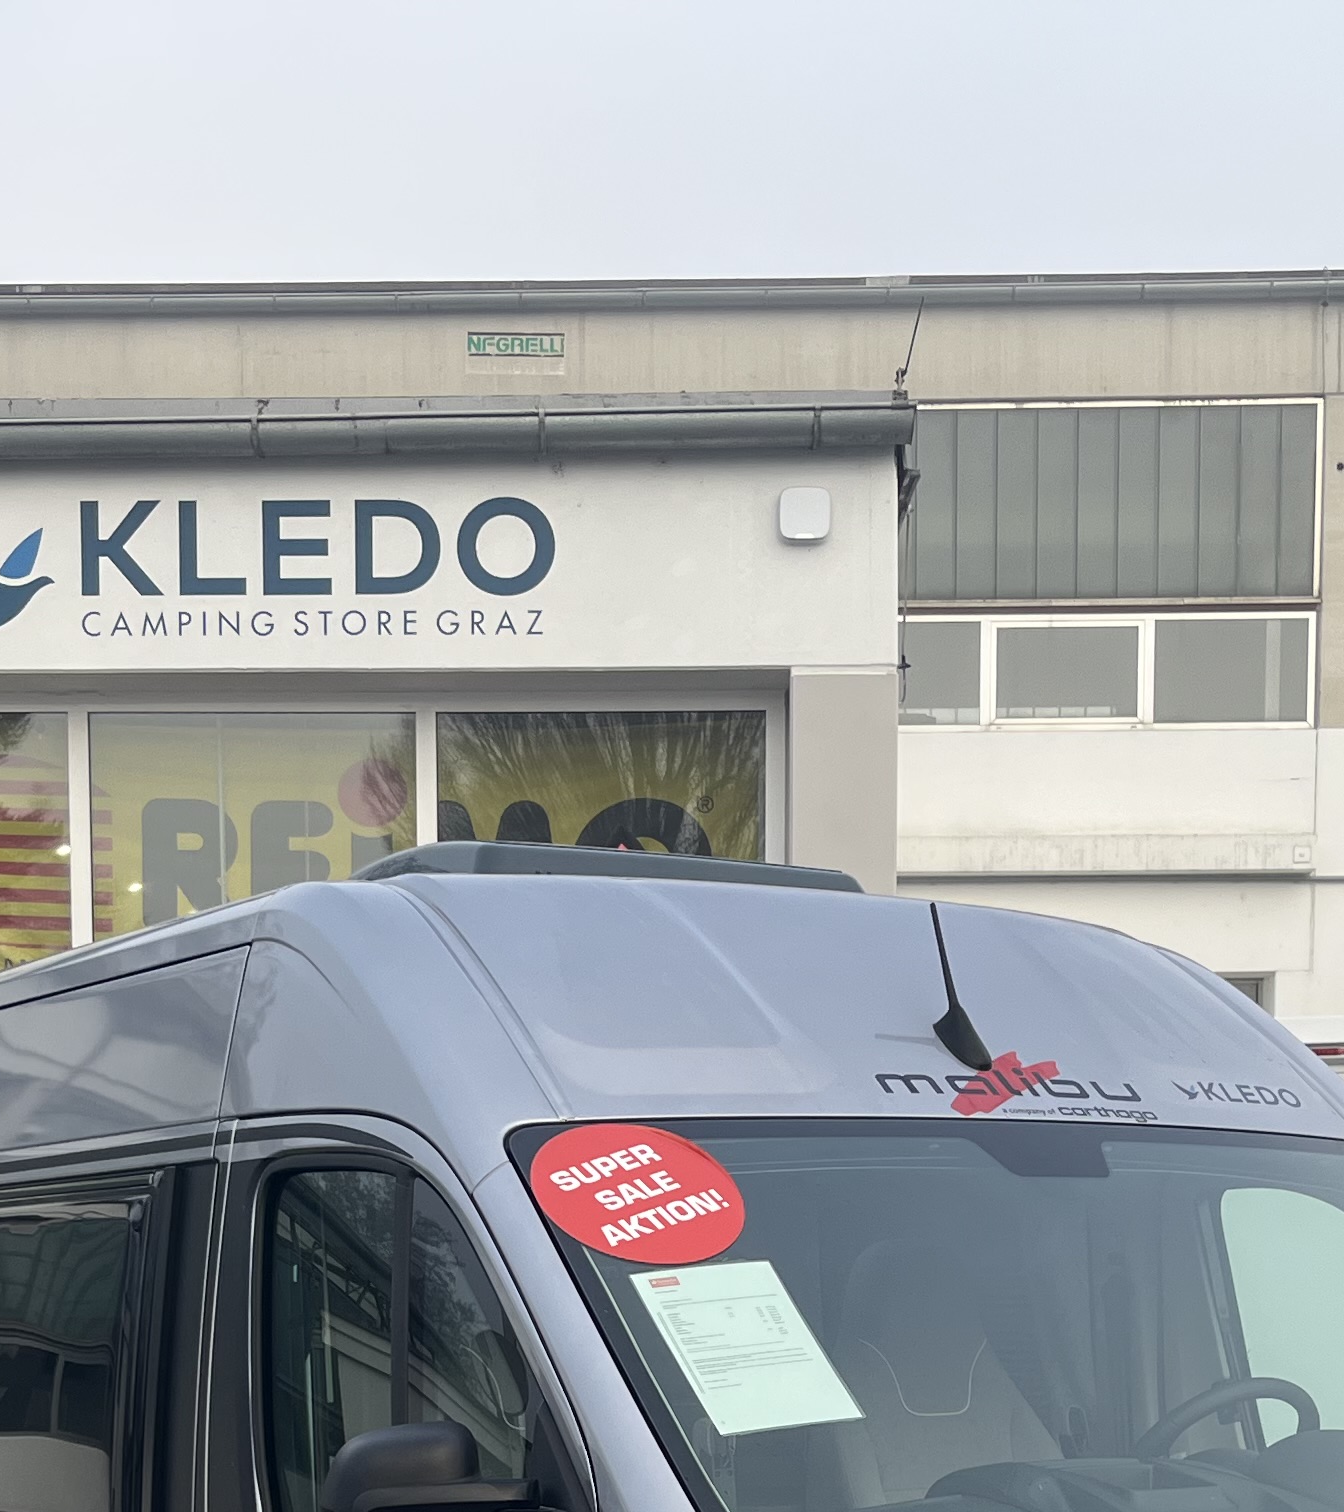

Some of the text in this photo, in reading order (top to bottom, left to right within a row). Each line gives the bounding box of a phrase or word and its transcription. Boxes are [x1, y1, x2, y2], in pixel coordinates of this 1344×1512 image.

[80, 497, 556, 596] KLEDO
[82, 608, 544, 637] CAMPING STORE GRAZ
[875, 1067, 1301, 1108] malibu KLEDO
[1058, 1106, 1158, 1123] carthago
[549, 1144, 662, 1192] SUPER
[594, 1170, 682, 1211] SALE
[600, 1188, 730, 1247] AKTION!
